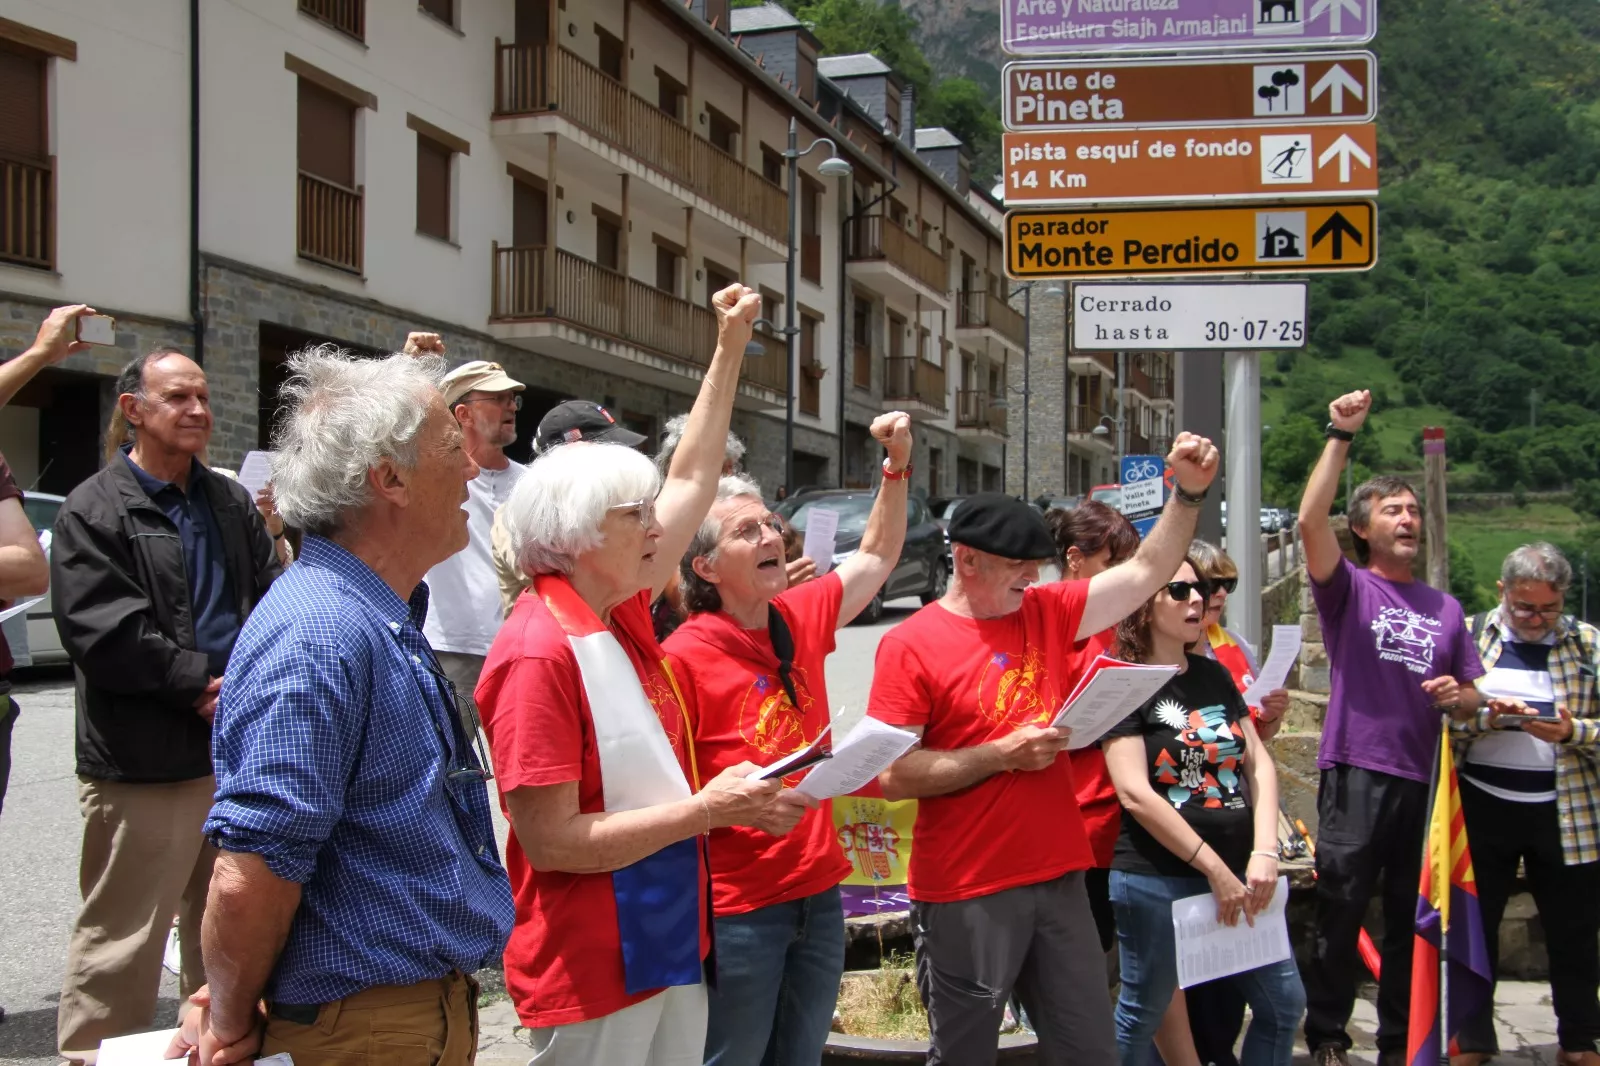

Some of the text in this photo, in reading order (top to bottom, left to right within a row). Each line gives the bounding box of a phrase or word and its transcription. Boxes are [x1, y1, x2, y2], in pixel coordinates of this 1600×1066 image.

[1016, 0, 1179, 17] Arte y Naturaleza
[1016, 14, 1247, 41] Escultura Siajh Armajani
[1016, 71, 1116, 91] Valle de
[1016, 94, 1124, 122] Pineta
[1010, 139, 1252, 165] pista esquí de fondo
[1010, 170, 1087, 188] 14 Km
[1018, 218, 1109, 240] parador
[1018, 237, 1239, 268] Monte Perdido
[1080, 295, 1172, 312] Cerrado
[1095, 324, 1169, 340] hasta
[1125, 492, 1144, 500] Valle
[1180, 747, 1209, 766] FIESTA
[1179, 766, 1207, 788] SOL
